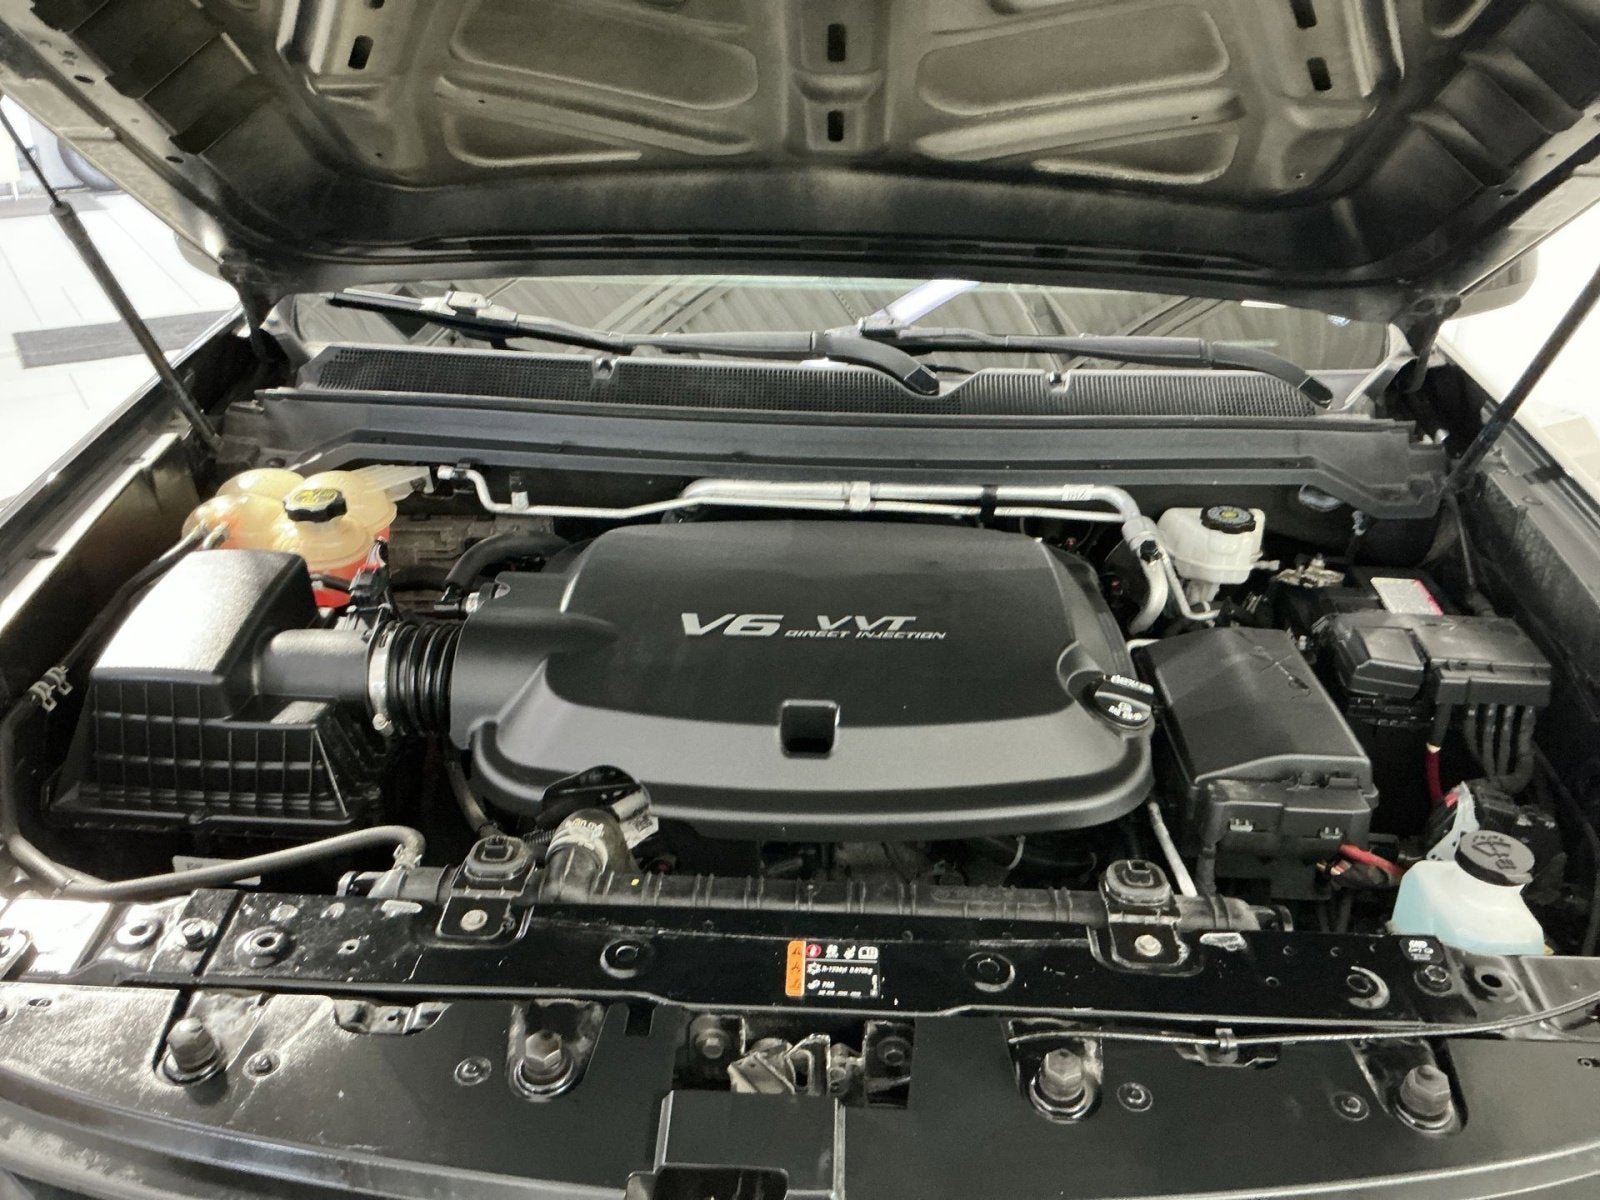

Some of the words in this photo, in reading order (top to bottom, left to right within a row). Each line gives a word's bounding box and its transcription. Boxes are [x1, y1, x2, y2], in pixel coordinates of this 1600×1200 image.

[681, 612, 785, 637] V6
[816, 615, 917, 631] VVT
[784, 630, 850, 639] DIRECT
[855, 630, 946, 640] INJECTION
